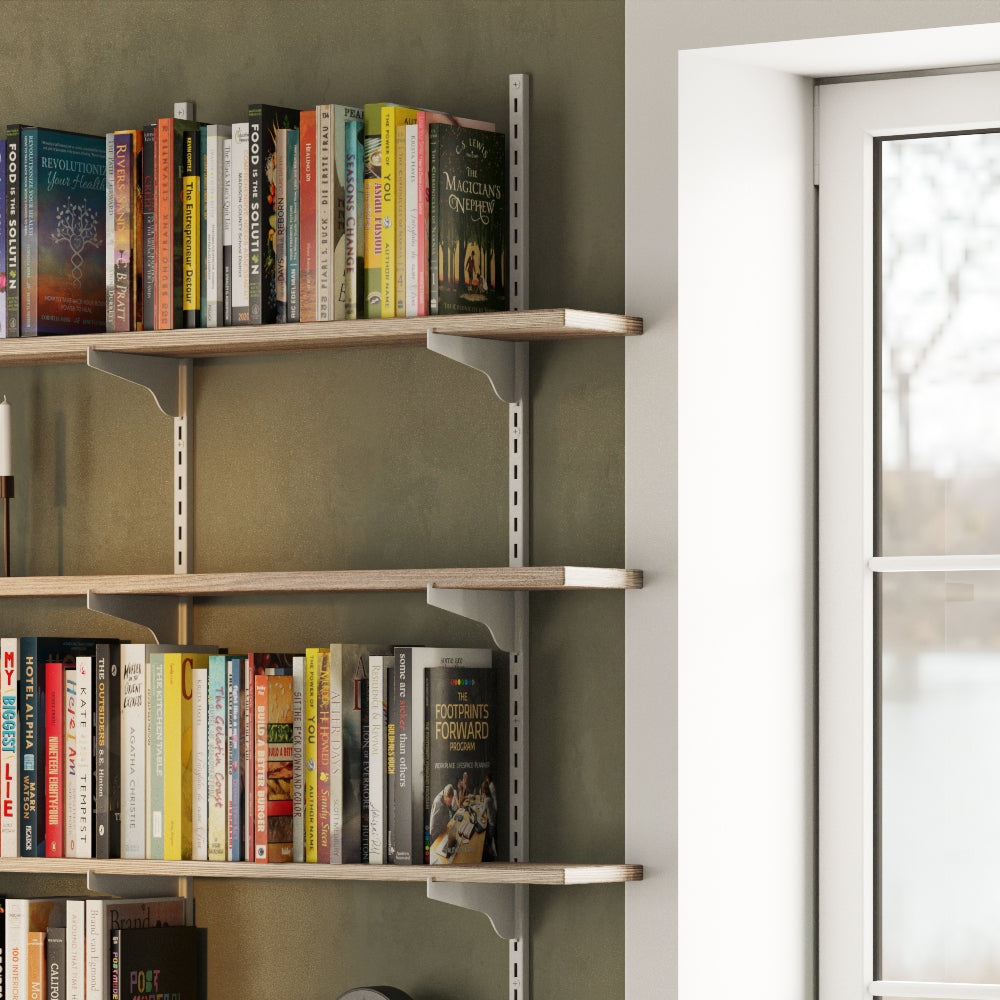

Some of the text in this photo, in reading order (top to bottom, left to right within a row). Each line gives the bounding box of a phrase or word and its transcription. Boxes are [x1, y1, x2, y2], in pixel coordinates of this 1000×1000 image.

[251, 124, 259, 164] FOOD
[251, 180, 259, 198] THE
[443, 172, 500, 199] MAGICIAN'S
[466, 166, 478, 178] THE
[9, 188, 16, 196] IS
[448, 194, 495, 224] NEPHEW
[346, 154, 356, 274] SEASONS CHANGE
[184, 204, 193, 266] Entrepreneur
[26, 656, 34, 749] HOTEL ALPHA
[436, 704, 489, 720] FOOTPRINTS
[458, 692, 468, 702] THE
[2, 651, 16, 817] MY BIGGEST LIE
[258, 706, 266, 737] BUILD
[399, 654, 408, 788] some are sicker than others
[436, 722, 489, 740] FORWARD
[48, 736, 59, 774] NINETEEN
[215, 687, 225, 808] The Gelatin Coast
[450, 742, 476, 751] PROGRAM
[258, 750, 266, 788] BETTER
[48, 778, 59, 824] EIGHTY-FOUR
[258, 791, 266, 832] BURGER
[88, 956, 98, 992] Egmond
